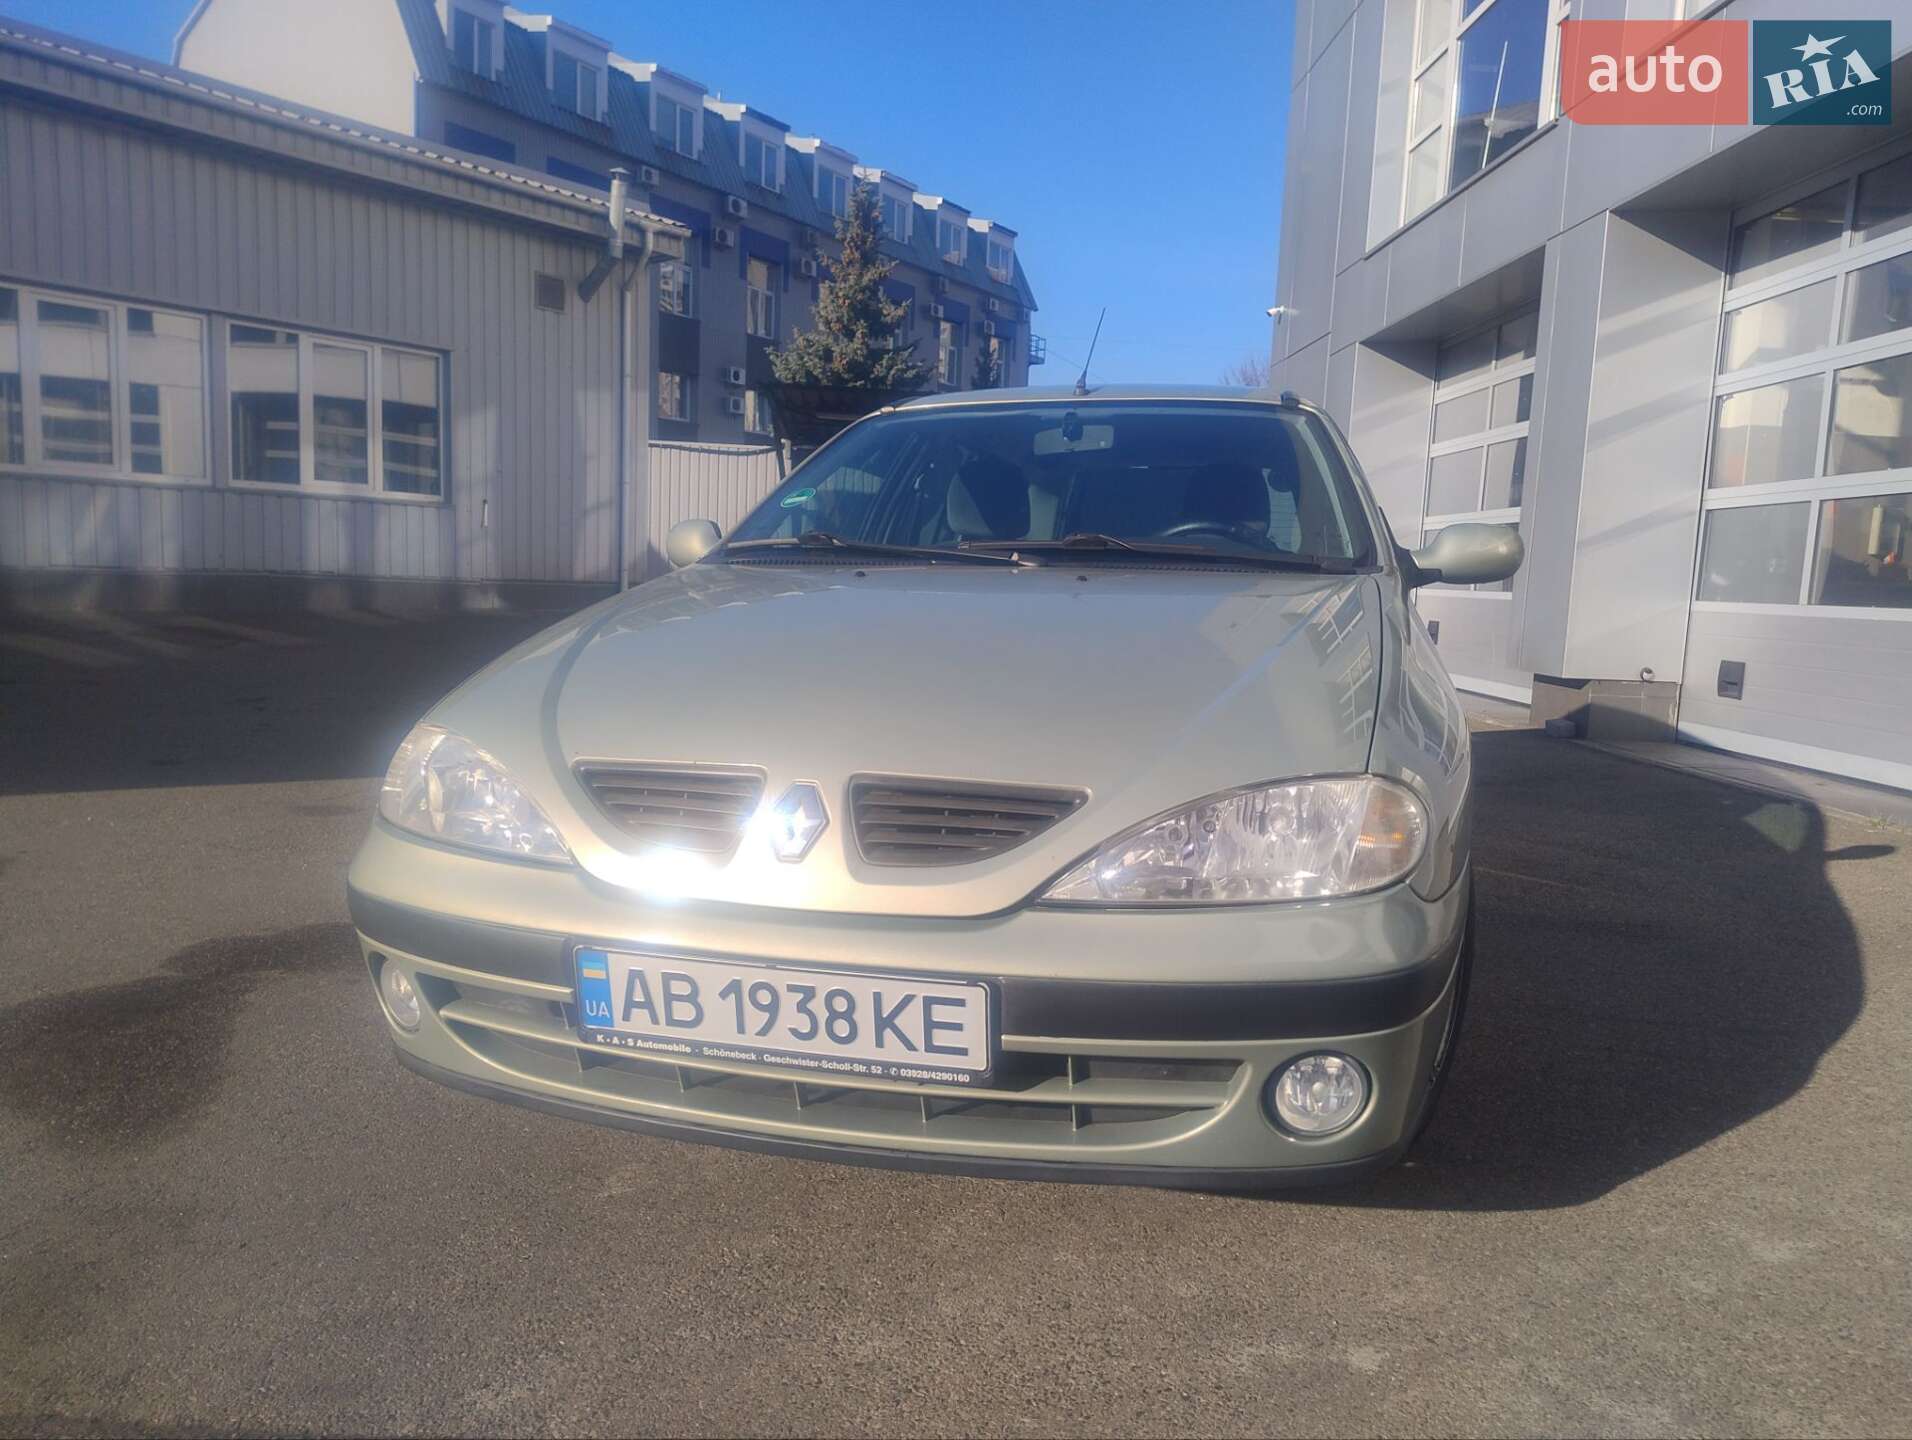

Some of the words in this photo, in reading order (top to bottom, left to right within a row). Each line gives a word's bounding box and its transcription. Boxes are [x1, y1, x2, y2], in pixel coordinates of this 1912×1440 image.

[585, 998, 611, 1019] UA
[621, 967, 704, 1030] AB
[718, 977, 859, 1046] 1938
[872, 990, 970, 1057] KE
[636, 1039, 692, 1053] Automobile
[870, 1065, 882, 1074] 52
